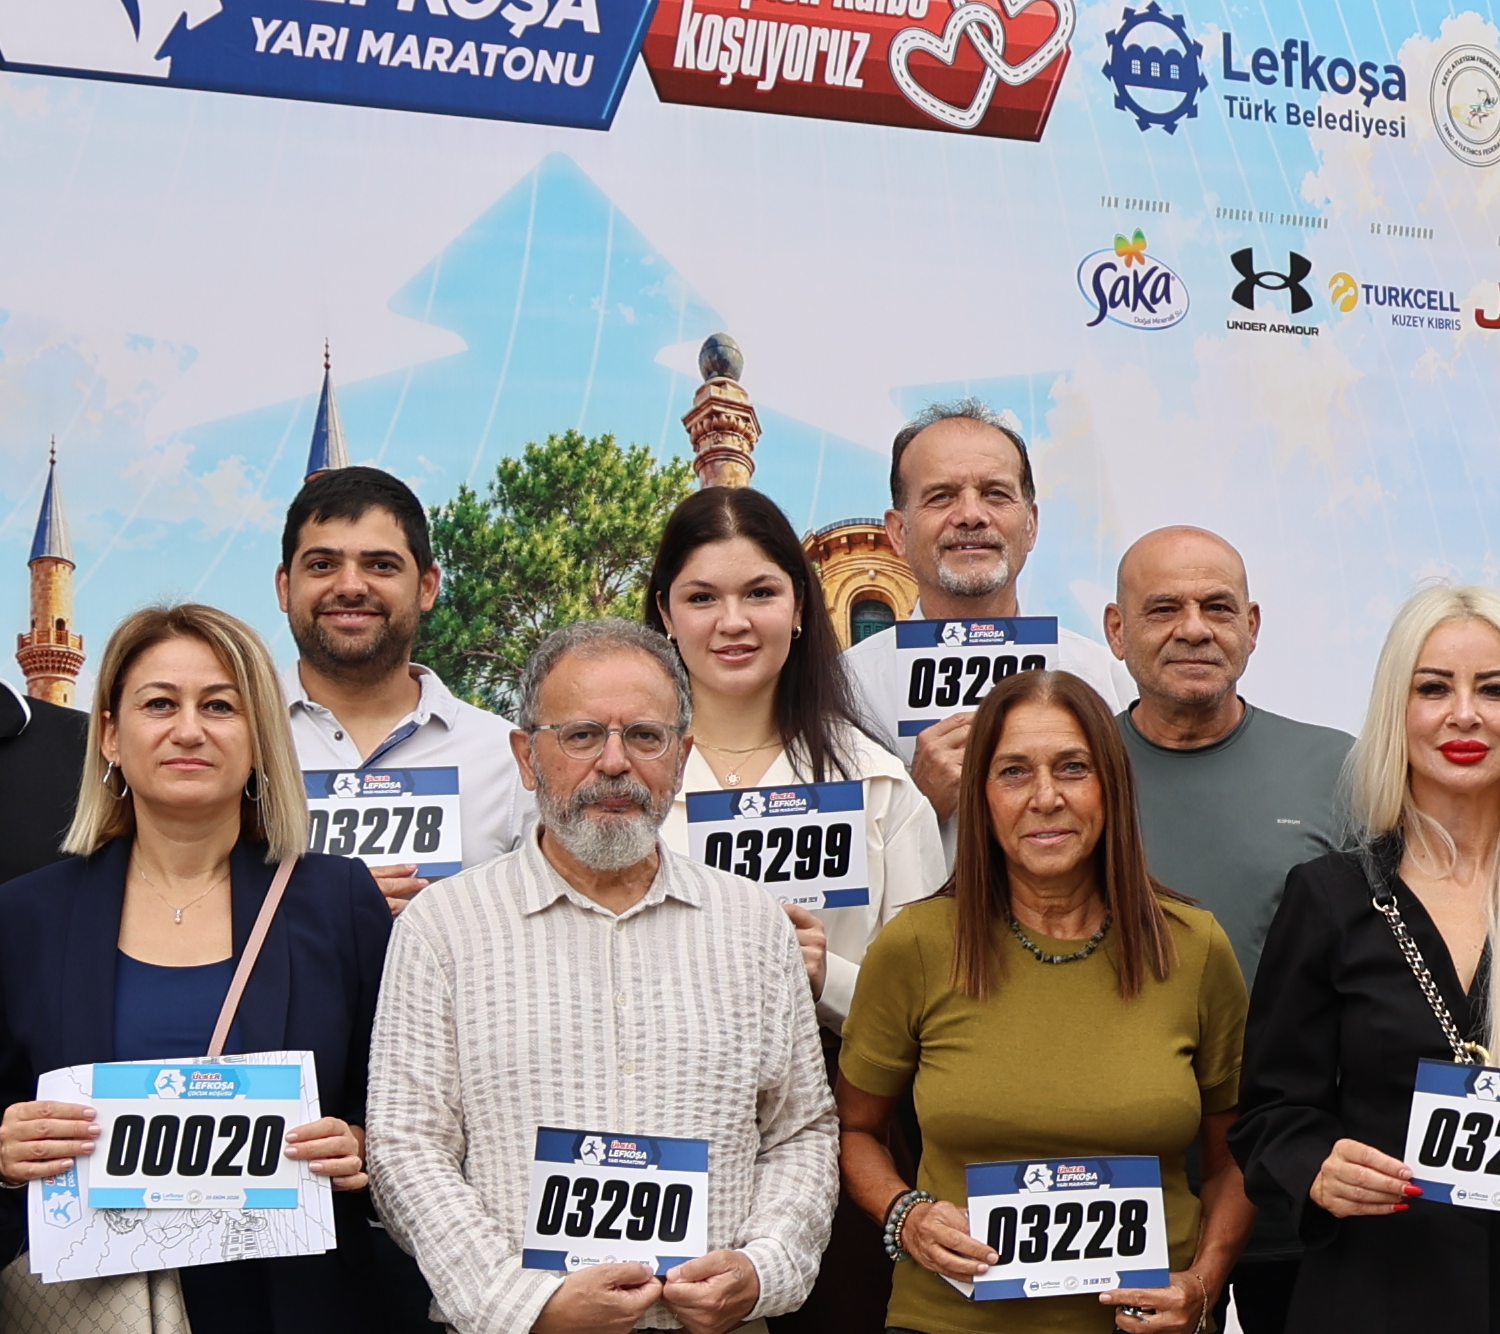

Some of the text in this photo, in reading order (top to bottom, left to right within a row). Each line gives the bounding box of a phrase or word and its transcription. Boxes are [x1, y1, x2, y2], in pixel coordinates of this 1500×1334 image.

[250, 16, 596, 88] YARI MARATONU
[1222, 31, 1407, 108] Lefkoşa
[1223, 94, 1407, 139] Türk Belediyesi
[1361, 283, 1461, 313] TURKCELL
[1226, 320, 1319, 337] UNDER ARMOUR
[1391, 314, 1461, 331] KUZEY KIBRIS
[704, 822, 852, 883] 03299
[188, 1081, 235, 1091] LEFKOŞA
[106, 1114, 285, 1177] 00020
[608, 1148, 647, 1160] LEFKOŞA
[1056, 1172, 1098, 1182] LEFKOŞA
[536, 1174, 693, 1242] 03290
[987, 1199, 1149, 1266] 03228
